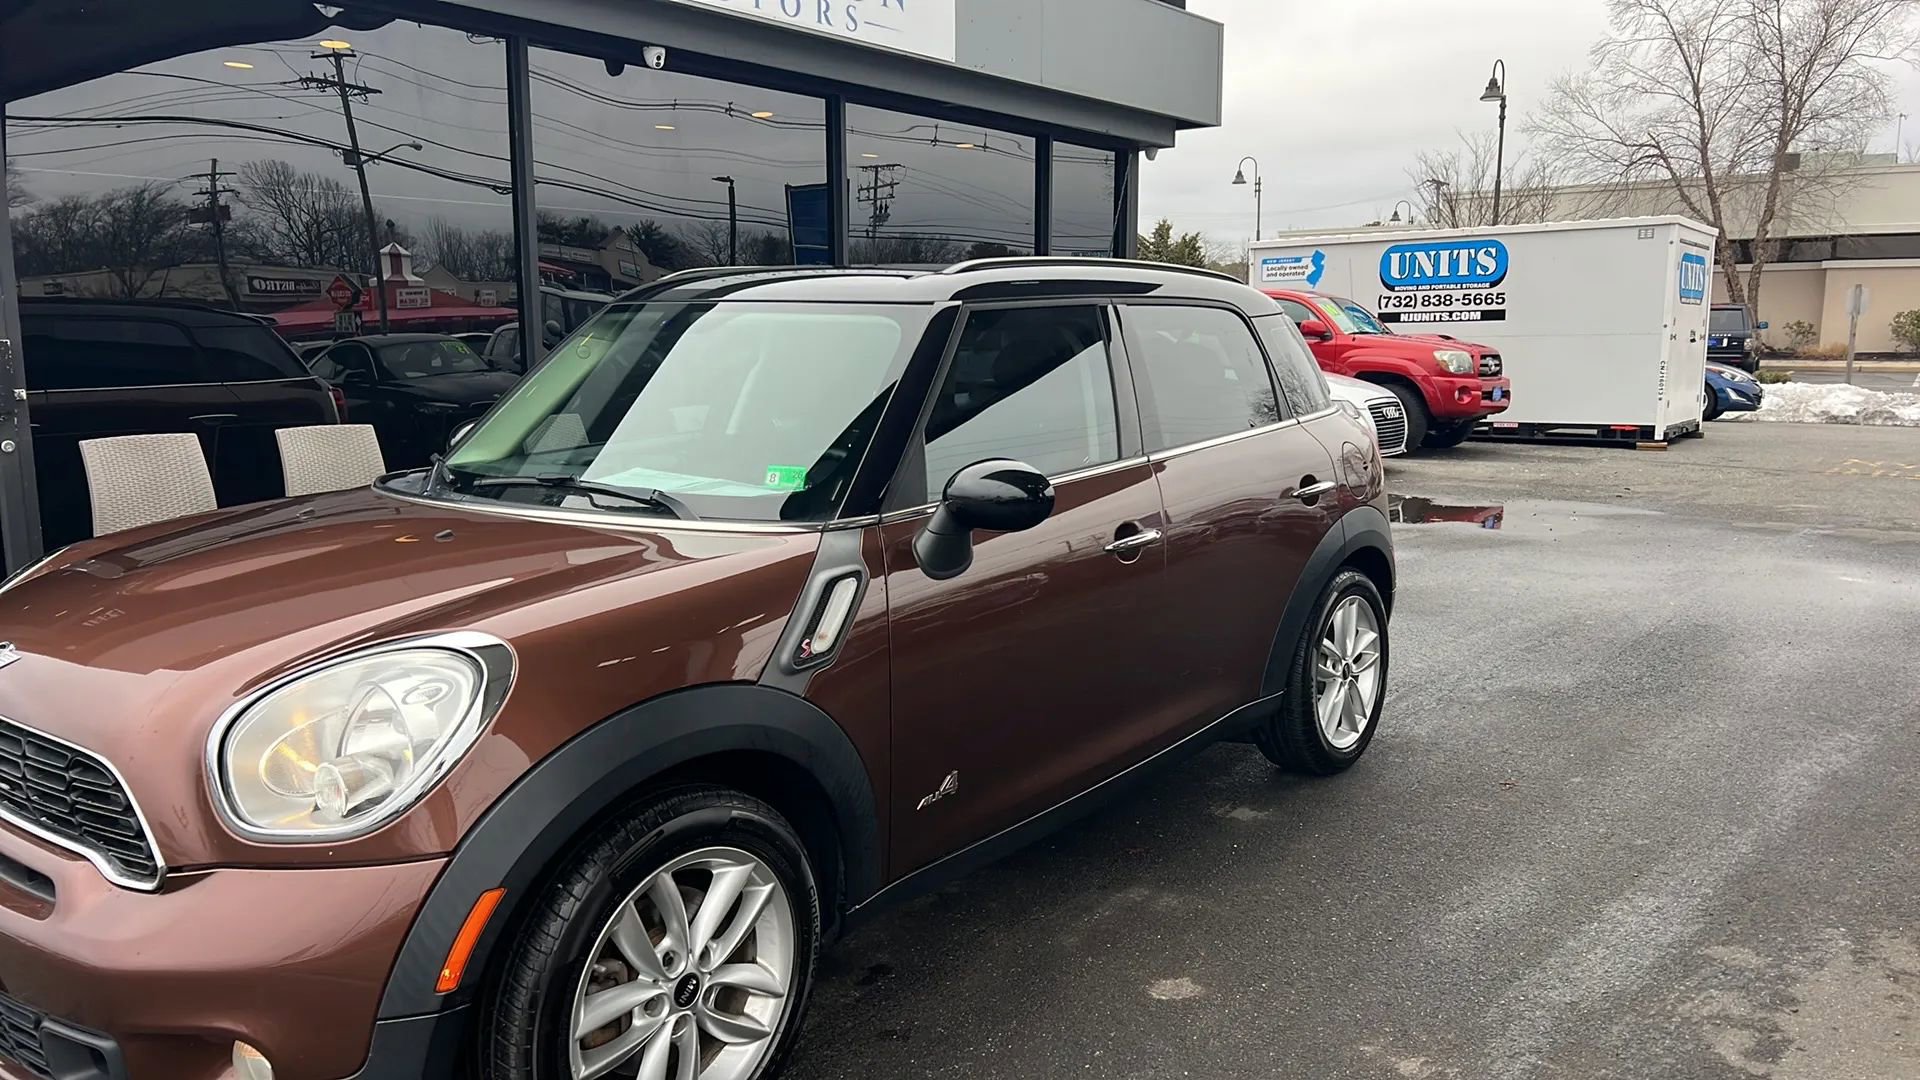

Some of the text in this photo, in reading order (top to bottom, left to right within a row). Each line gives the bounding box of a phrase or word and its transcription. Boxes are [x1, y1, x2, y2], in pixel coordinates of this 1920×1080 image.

[1389, 247, 1497, 279] UNITS
[1378, 293, 1506, 310] (732) 838-5665
[1400, 311, 1482, 322] NJUNITS.COM
[769, 473, 776, 483] 8
[800, 639, 810, 657] S
[679, 978, 697, 1004] MINI
